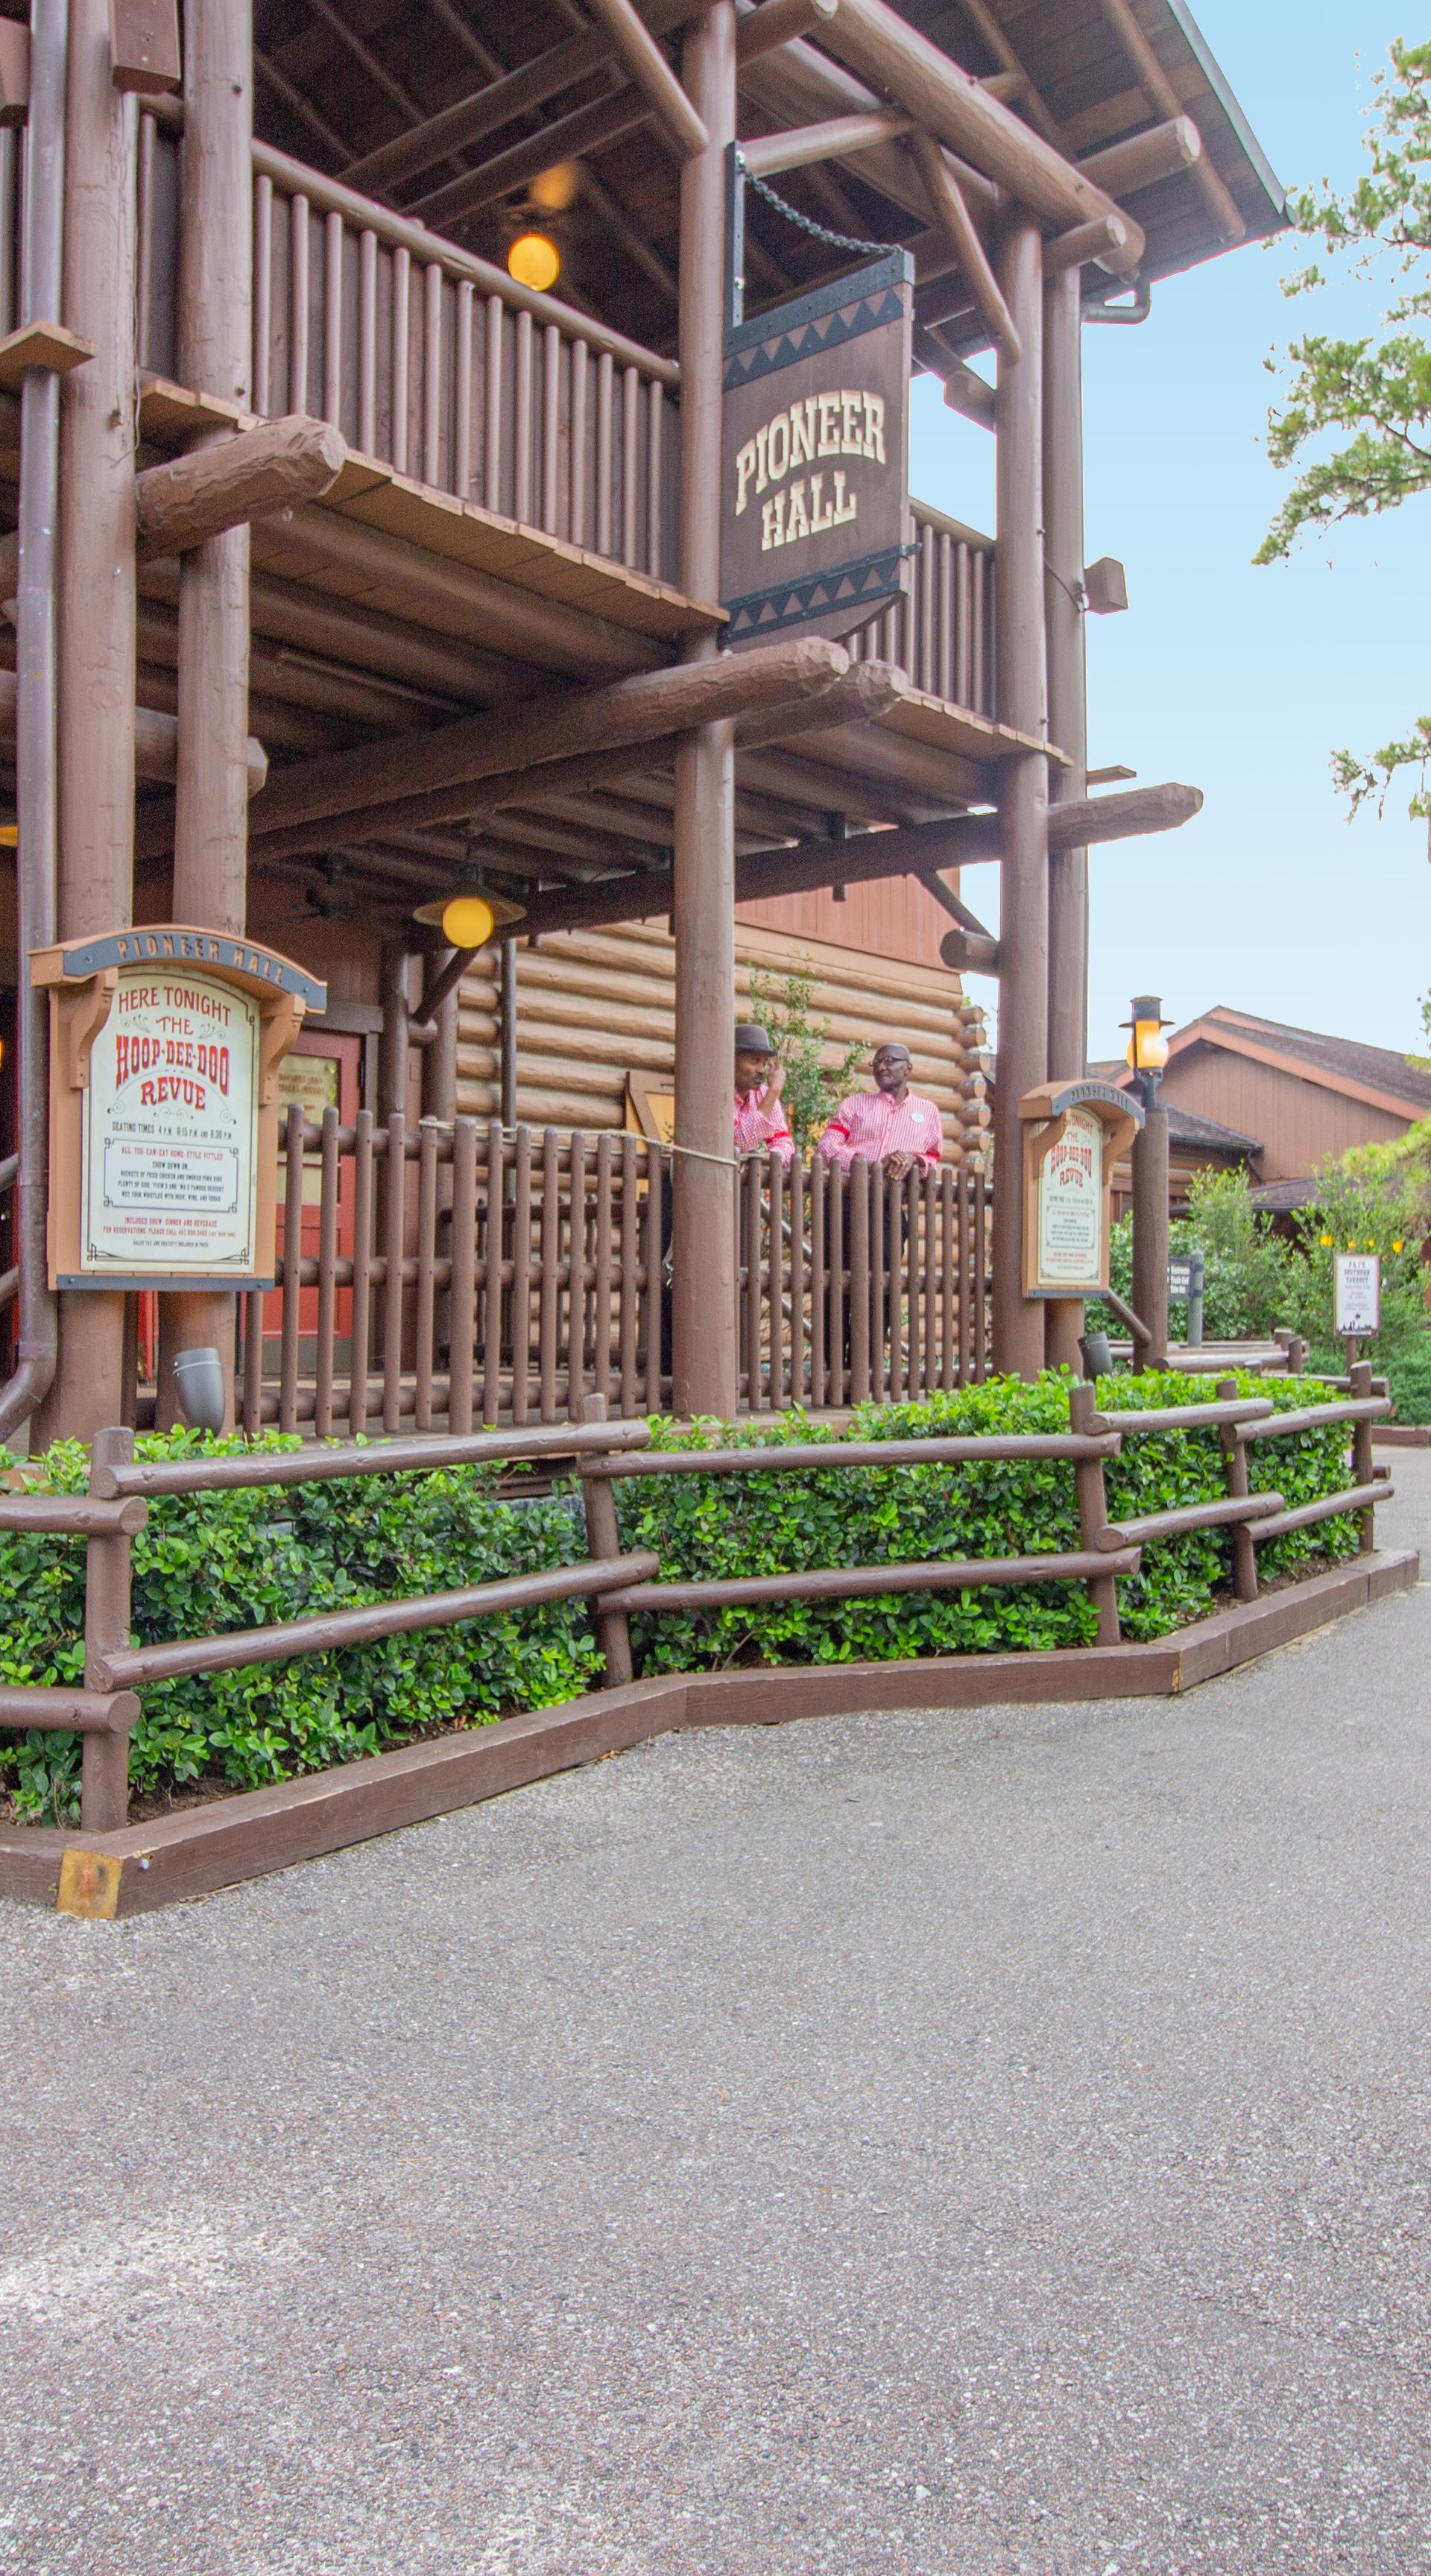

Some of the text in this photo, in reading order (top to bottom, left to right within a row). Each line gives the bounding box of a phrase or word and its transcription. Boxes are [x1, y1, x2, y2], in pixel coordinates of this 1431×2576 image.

[735, 388, 886, 517] PIONEER
[761, 470, 857, 552] HALL
[116, 935, 283, 984] PIONEER HALL
[119, 986, 231, 1027] HERE TONIGHT
[156, 1015, 193, 1035] THE
[115, 1034, 230, 1097] HOOP-DEE-DOO
[140, 1076, 206, 1110] REVUE
[112, 1121, 136, 1133] SEATING
[138, 1123, 154, 1134] TIMES
[158, 1126, 162, 1134] 4
[1065, 1131, 1079, 1143] THE
[203, 1152, 223, 1161] VITTLES
[1060, 1167, 1083, 1187] REVUE
[124, 1216, 148, 1225] INCLUDES
